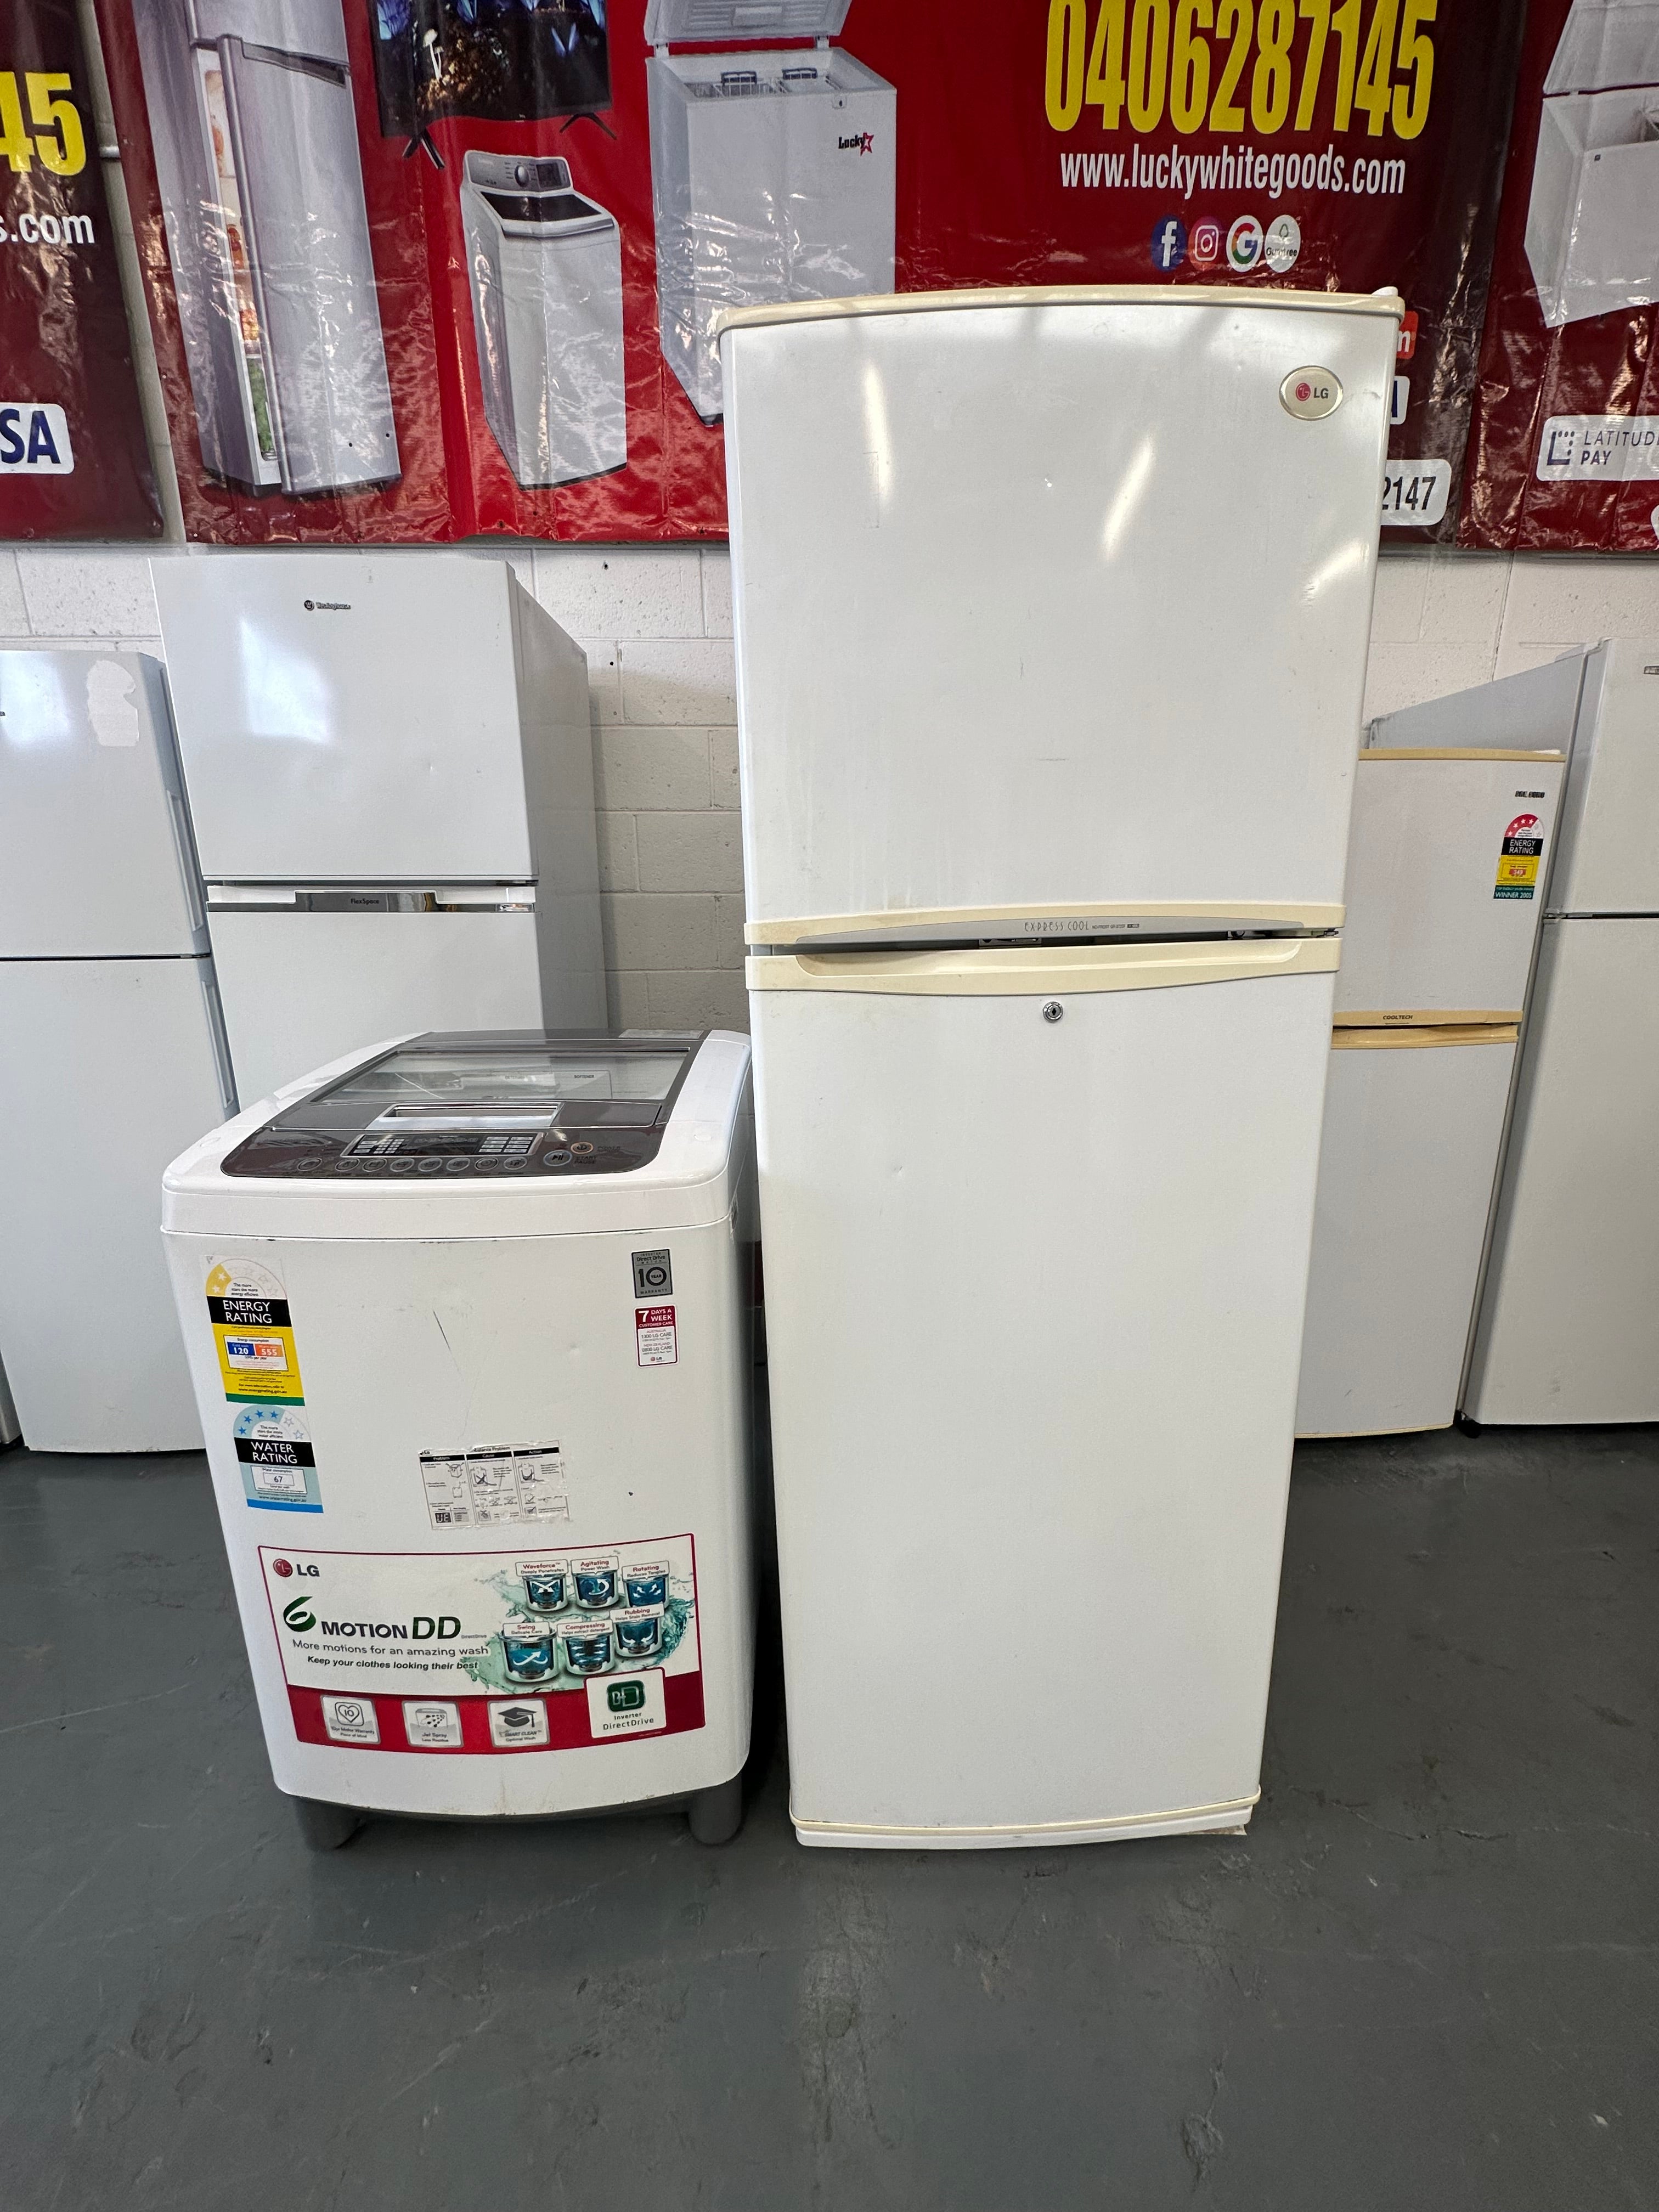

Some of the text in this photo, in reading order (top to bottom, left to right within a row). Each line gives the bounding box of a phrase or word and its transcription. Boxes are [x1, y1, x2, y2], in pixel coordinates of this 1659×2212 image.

[1045, 0, 1437, 139] 0406287145
[838, 134, 865, 149] Lucky
[1060, 143, 1406, 200] www.luckywhitegoods.com
[1313, 387, 1329, 399] LG
[1584, 431, 1659, 446] LATITUD
[1581, 450, 1612, 465] PAY
[1024, 922, 1064, 932] EXPRESS
[1068, 921, 1089, 931] COOL
[222, 1300, 270, 1312] ENERGY
[225, 1312, 273, 1323] RATING
[638, 1310, 650, 1323] 7
[251, 1441, 295, 1453] WATER
[252, 1452, 297, 1464] RATING
[296, 1564, 320, 1577] LG
[283, 1596, 317, 1633] 6
[321, 1621, 408, 1639] MOTION
[412, 1616, 461, 1640] DD
[565, 1622, 605, 1630] Compressing
[292, 1639, 320, 1650] More
[323, 1644, 368, 1654] motions
[370, 1645, 386, 1654] for
[407, 1647, 456, 1657] amazing
[459, 1646, 488, 1655] wash
[307, 1656, 330, 1666] Keep
[356, 1660, 391, 1668] clothes
[393, 1661, 429, 1671] looking
[456, 1661, 478, 1669] best
[614, 1712, 642, 1720] Inverter
[603, 1718, 654, 1730] DirectDrive
